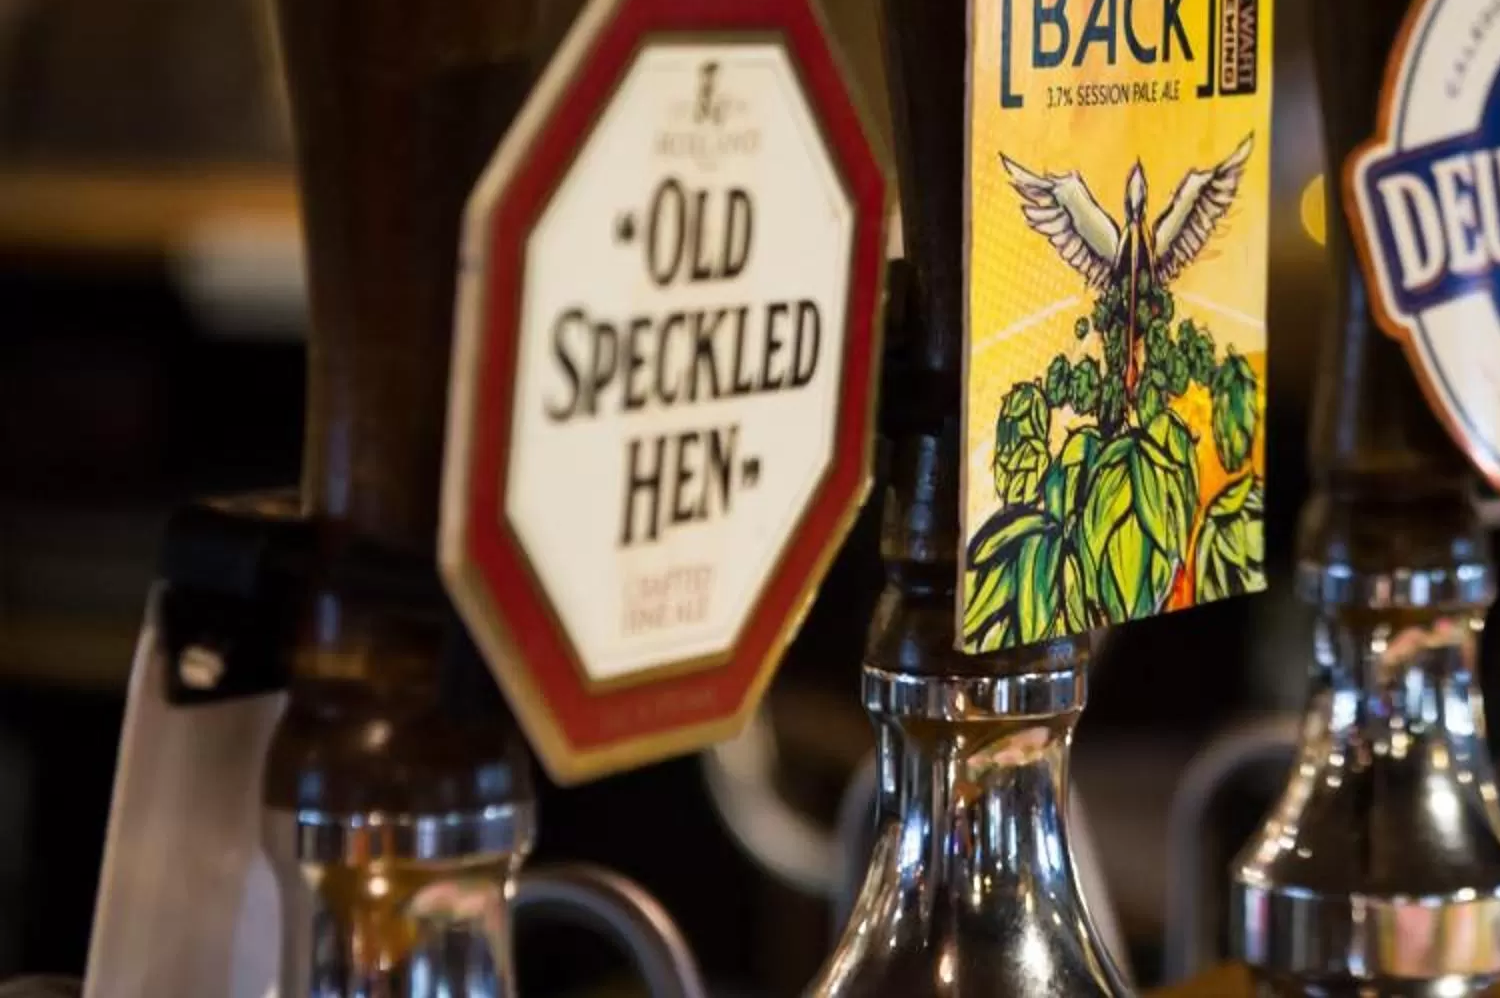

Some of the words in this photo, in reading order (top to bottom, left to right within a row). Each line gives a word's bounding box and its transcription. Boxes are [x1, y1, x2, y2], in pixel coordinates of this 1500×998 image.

[1076, 81, 1130, 106] SESSION
[1132, 80, 1158, 104] PALE
[1160, 79, 1181, 101] ALE
[546, 299, 822, 424] SPECKLED
